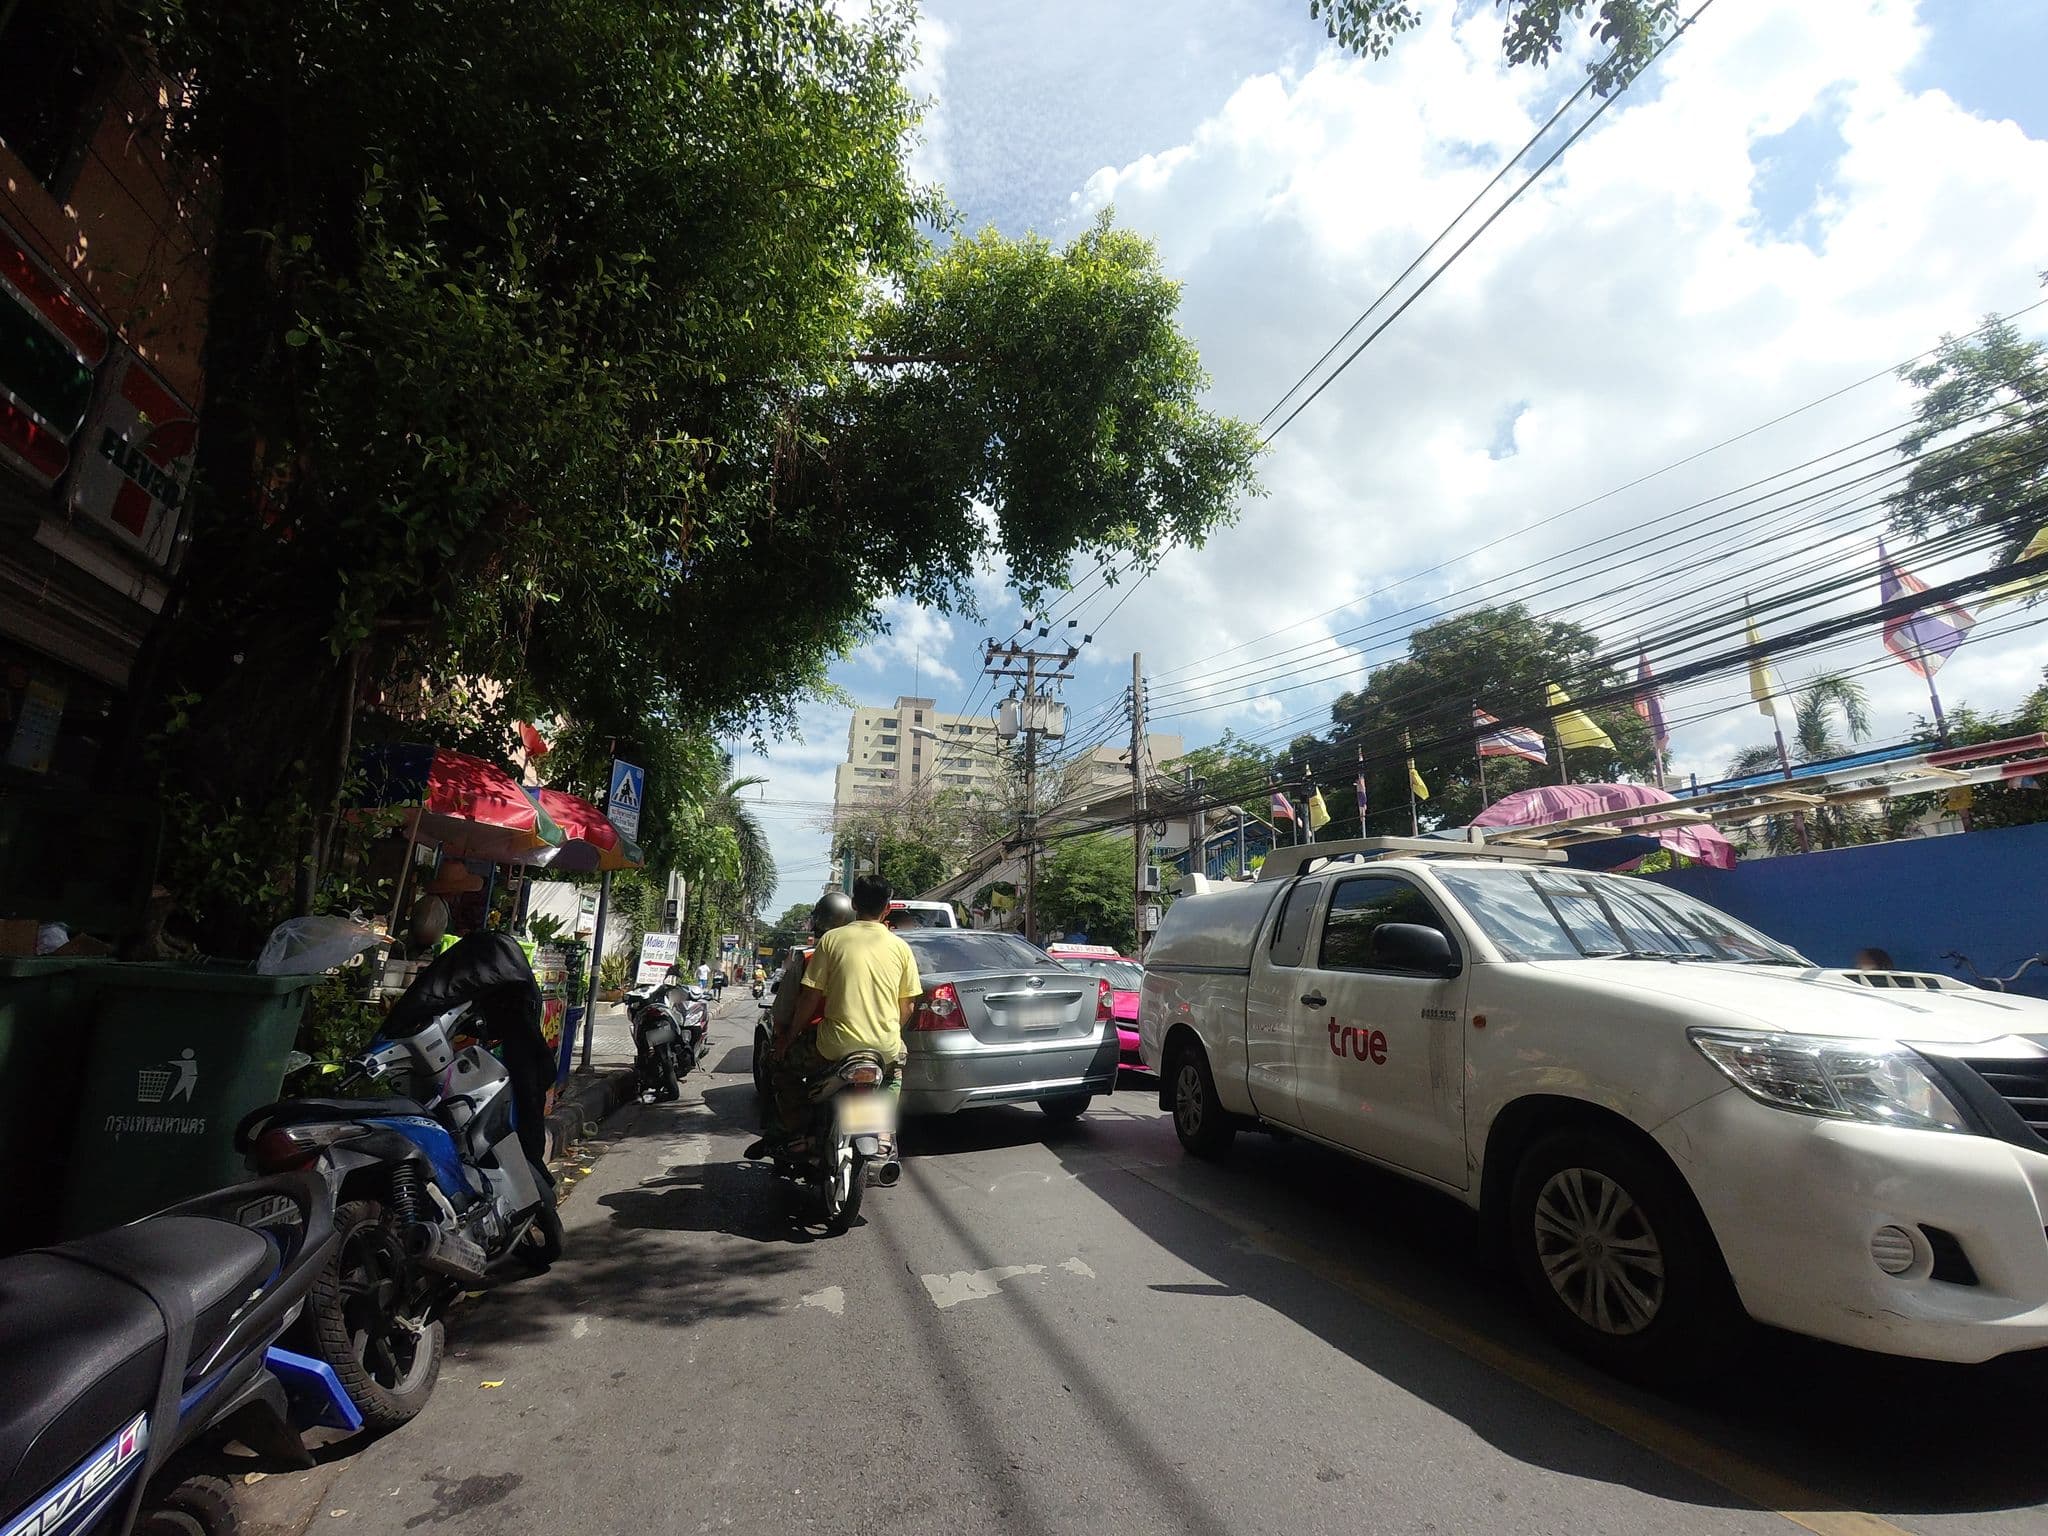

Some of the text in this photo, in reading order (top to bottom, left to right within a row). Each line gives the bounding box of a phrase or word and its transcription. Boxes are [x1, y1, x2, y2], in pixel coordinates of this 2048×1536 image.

[1327, 1016, 1387, 1066] true
[103, 1114, 207, 1142] กรุงเทพมหานคร
